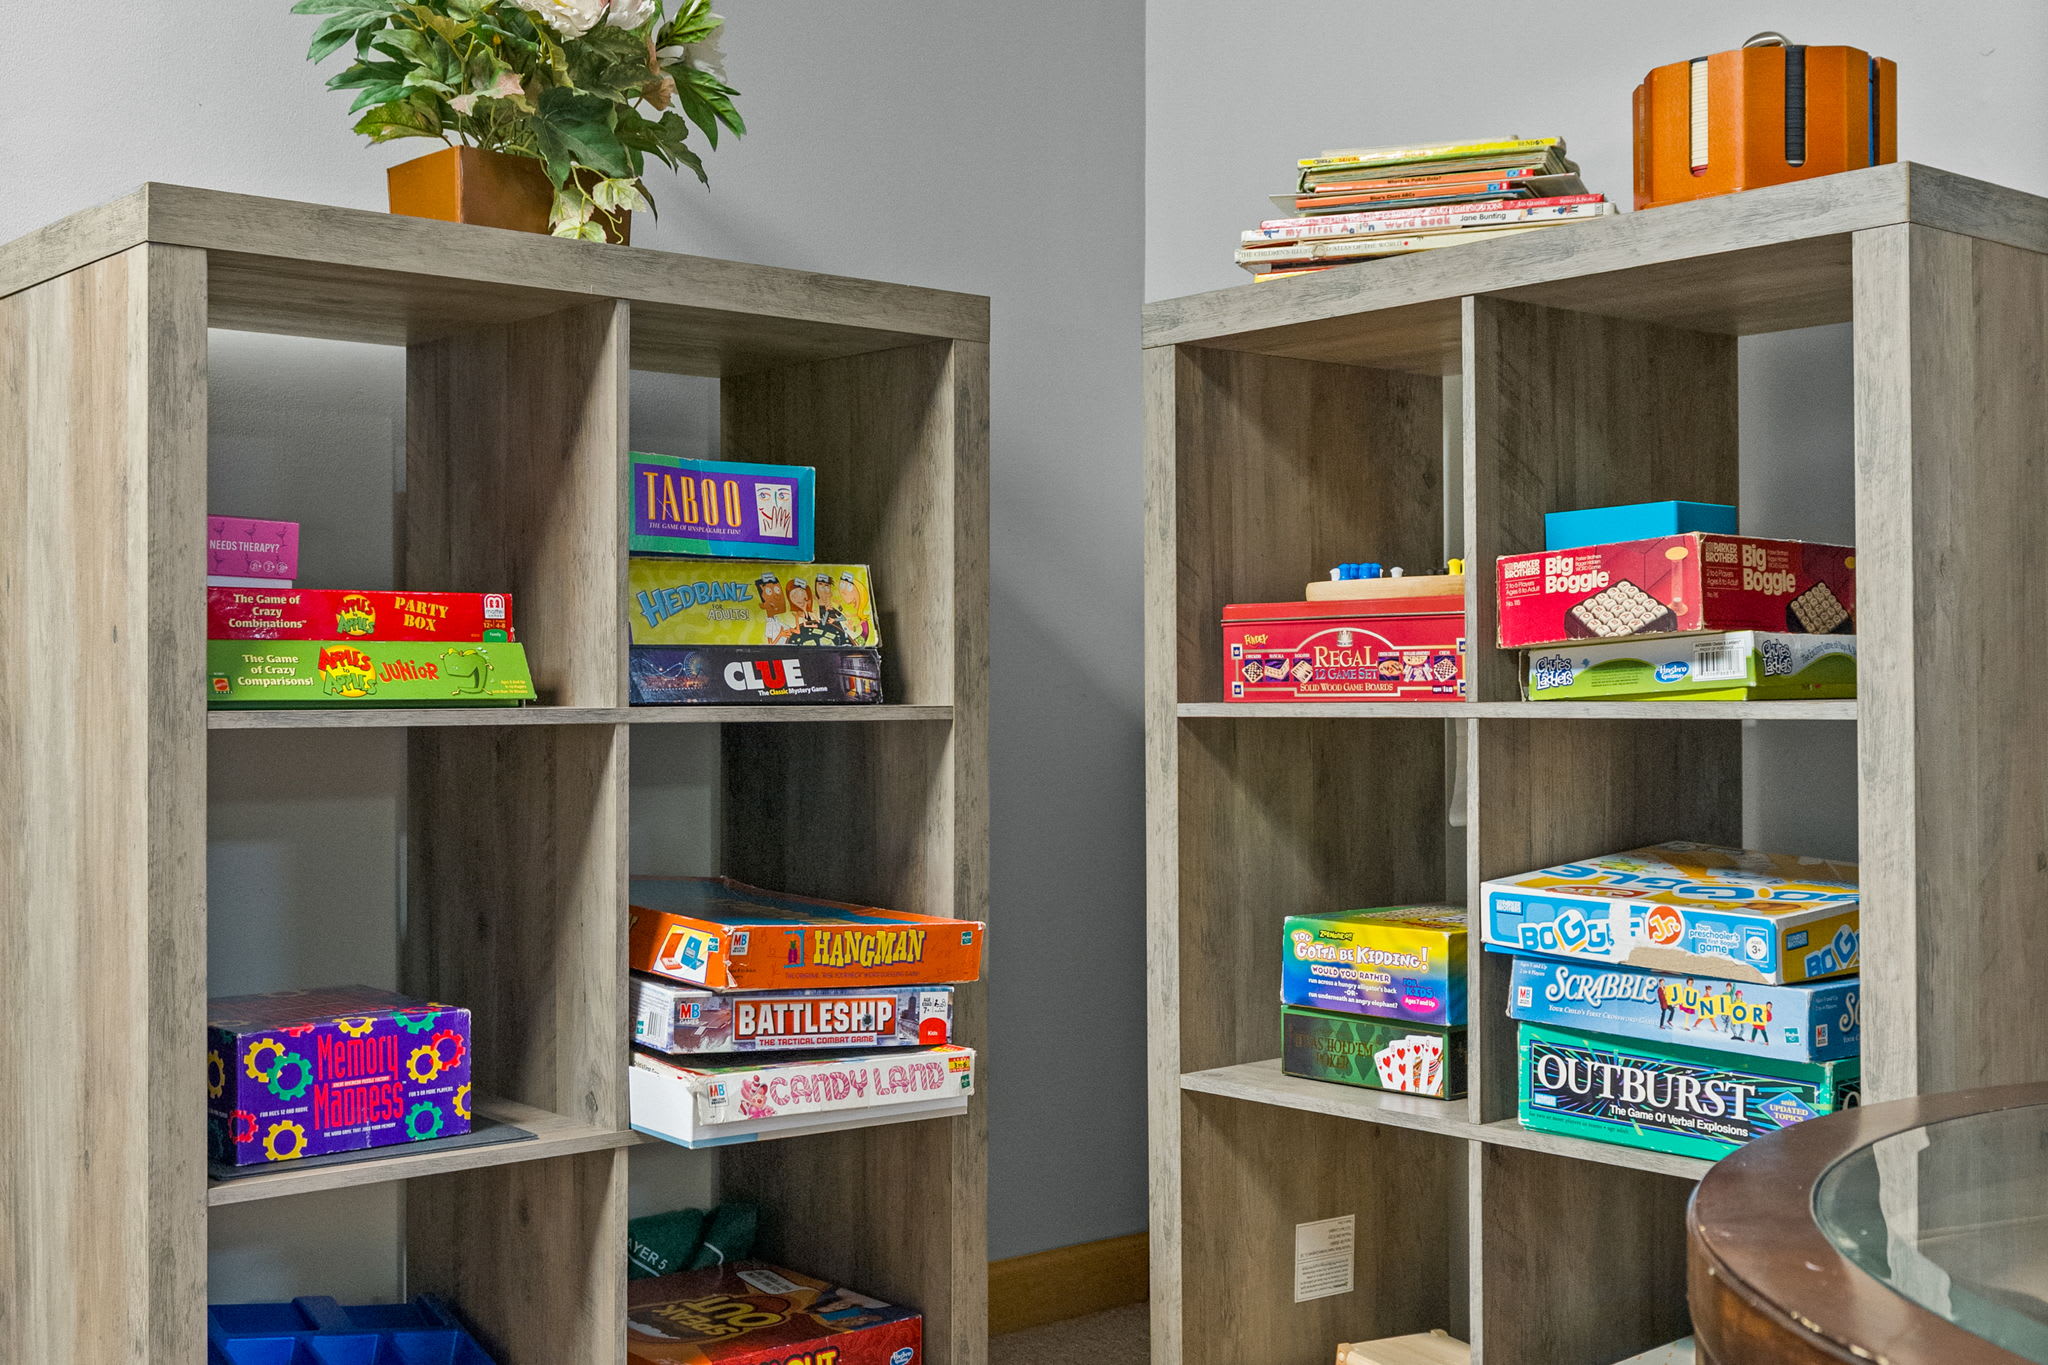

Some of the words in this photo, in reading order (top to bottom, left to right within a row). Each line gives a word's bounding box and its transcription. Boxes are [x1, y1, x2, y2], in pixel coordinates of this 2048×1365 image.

[1460, 212, 1477, 222] Jane
[1479, 211, 1507, 221] Bunting
[1285, 229, 1301, 239] my
[1308, 225, 1333, 234] first
[1420, 216, 1450, 227] book
[643, 472, 742, 527] TABOO
[687, 525, 726, 534] UNSPEAKABLE
[210, 539, 237, 551] NEEDS
[239, 541, 280, 553] THERAPY?
[1713, 542, 1738, 553] PARKER
[1513, 559, 1540, 569] PARKER
[1705, 552, 1738, 564] BROTHERS
[1742, 544, 1767, 572] Big
[1545, 555, 1574, 576] Big
[1504, 568, 1540, 578] BROTHERS
[1545, 570, 1609, 594] Boggle
[1743, 568, 1796, 596] Boggle
[233, 593, 253, 604] The
[256, 594, 287, 604] Game
[289, 594, 300, 604] of
[1506, 588, 1518, 596] Ages
[394, 596, 448, 619] PARTY
[636, 581, 753, 628] HEDBANZ
[252, 607, 282, 618] Crazy
[707, 608, 750, 621] ADULTS!
[228, 618, 302, 629] Combinations
[403, 613, 436, 632] BOX
[242, 654, 264, 663] The
[266, 655, 299, 663] Game
[318, 646, 371, 671] APPLES
[1313, 646, 1378, 667] REGAL
[1536, 654, 1571, 673] Chutes
[1660, 664, 1688, 674] Hasbro
[251, 666, 264, 674] of
[265, 665, 296, 676] Crazy
[724, 659, 805, 691] CLUE
[1315, 668, 1326, 680] 12
[1327, 668, 1357, 680] GAME
[1358, 667, 1378, 680] SET
[237, 677, 314, 688] Comparisons!
[323, 670, 378, 696] APPLES
[1300, 683, 1319, 692] SOLID
[1320, 683, 1342, 691] WOOD
[1343, 682, 1363, 691] GAME
[1365, 682, 1394, 691] BOARDS
[758, 689, 770, 697] The
[769, 688, 789, 696] Classic
[788, 687, 812, 696] Mystery
[1650, 915, 1681, 941] Jr.
[733, 934, 747, 946] MB
[1294, 932, 1312, 942] YOU
[1689, 929, 1739, 941] preschooler's
[813, 929, 926, 968] HANGMAN
[1699, 943, 1728, 954] game
[1751, 945, 1761, 954] 3+
[1806, 930, 1860, 977] BOG
[1296, 942, 1337, 960] GOTTA
[1339, 949, 1355, 961] BE
[1356, 945, 1428, 971] KIDDING!
[1312, 966, 1338, 976] WOULD
[1341, 970, 1357, 978] YOU
[1359, 972, 1390, 983] RATHER
[1337, 980, 1357, 990] hungry
[1384, 986, 1397, 994] back
[1403, 978, 1418, 986] FOR
[1545, 966, 1658, 1008] SCRABBLE
[1406, 987, 1434, 999] KIDS
[1519, 987, 1531, 999] MB
[1318, 993, 1347, 1002] underneath
[1355, 998, 1371, 1007] angry
[1371, 999, 1398, 1009] elephant?
[1405, 997, 1416, 1006] Ages
[1671, 986, 1764, 1023] JUNIOR
[679, 1003, 700, 1019] MB
[739, 1001, 892, 1035] BATTLESHIP
[759, 1038, 775, 1046] THE
[778, 1037, 815, 1046] TACTICAL
[816, 1036, 849, 1045] COMBAT
[851, 1035, 874, 1043] GAME
[317, 1033, 398, 1081] Memory
[437, 1086, 453, 1094] PLAYERS
[709, 1084, 725, 1097] MB
[769, 1068, 872, 1106] CANDY
[873, 1062, 944, 1096] LAND
[1537, 1054, 1756, 1121] OUTBURST
[295, 1106, 309, 1114] ABOVE
[1769, 1104, 1808, 1116] UPDATED
[1609, 1104, 1626, 1116] The
[1627, 1106, 1653, 1121] Game
[1654, 1111, 1667, 1123] Of
[1667, 1113, 1696, 1127] Verbal
[1697, 1119, 1749, 1138] Explosions
[1774, 1112, 1804, 1123] TOPICS
[381, 1122, 396, 1130] MEMORY
[659, 1258, 668, 1270] 5
